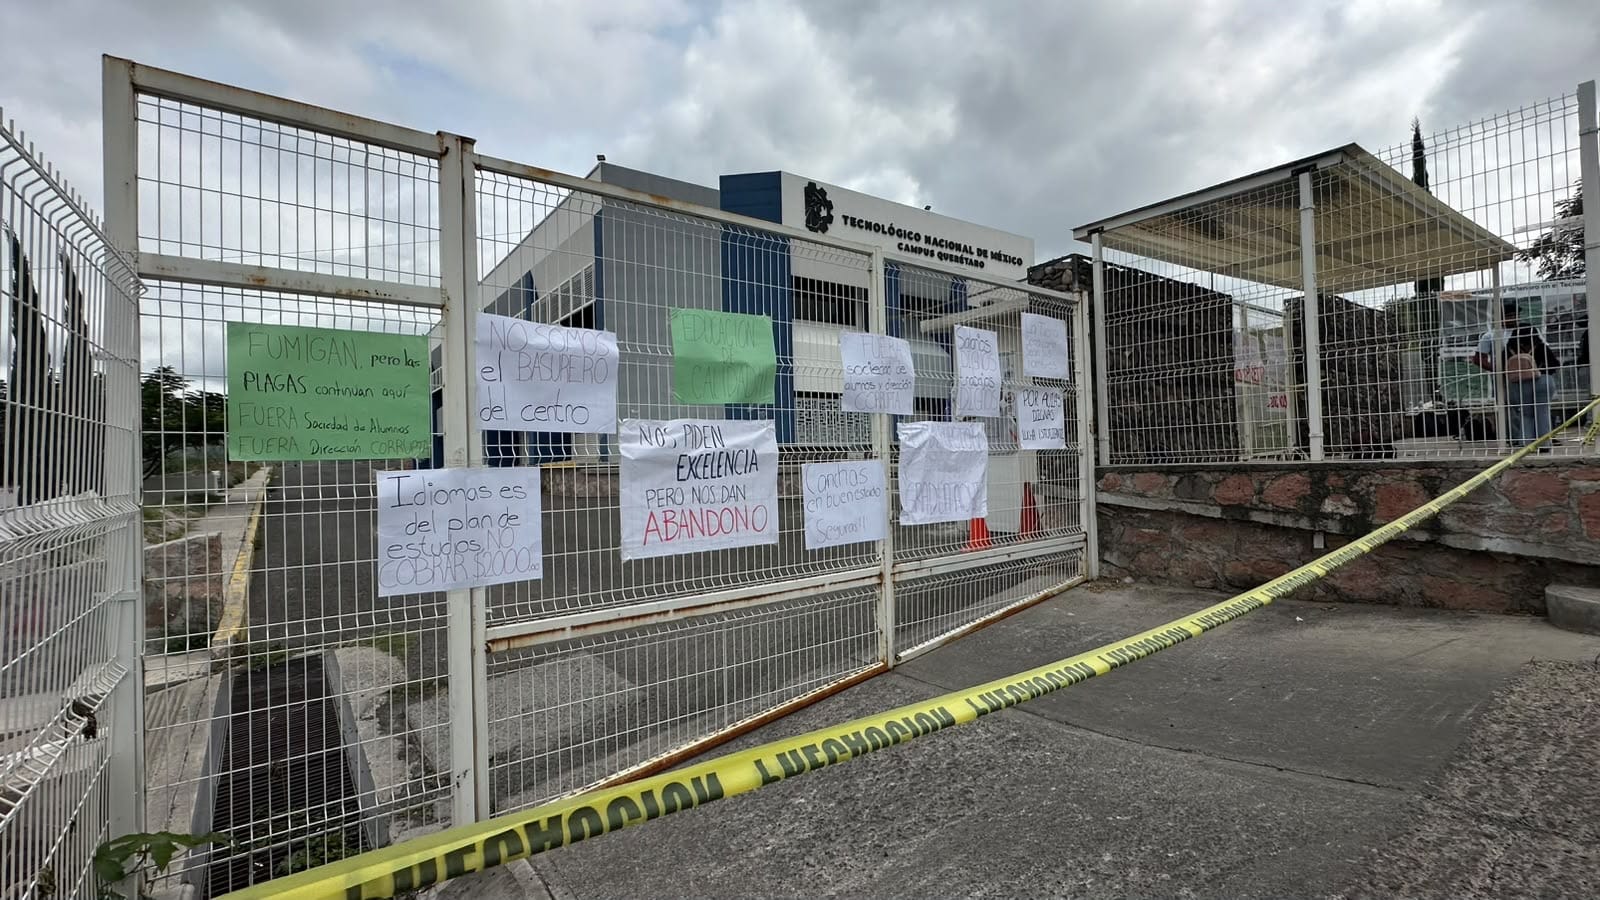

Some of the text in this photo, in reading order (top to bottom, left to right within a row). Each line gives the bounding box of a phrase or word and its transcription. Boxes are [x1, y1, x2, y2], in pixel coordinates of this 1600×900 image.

[842, 214, 1023, 266] TECNOLÓGICO NACIONAL DE MÉXICO
[897, 242, 985, 268] CAMPUS QUERÉTARO
[489, 320, 609, 356] NO SOMOS
[371, 353, 401, 368] pero
[404, 349, 421, 367] las
[480, 351, 502, 382] el
[243, 371, 307, 394] PLAGAS
[382, 384, 411, 400] aquí
[1022, 389, 1038, 407] POR
[238, 402, 410, 434] FUERA Sociedad de Alumnos
[480, 385, 590, 425] del centro
[238, 435, 298, 456] FUERA
[310, 439, 362, 455] Dirección
[639, 424, 725, 449] NOS PIDEN
[676, 449, 759, 482] EXCELENCIA
[806, 463, 868, 494] Canchas
[387, 475, 527, 508] Idiomas es
[646, 484, 746, 509] PERO NOS DAN
[806, 496, 823, 513] en
[826, 491, 853, 508] buen
[405, 504, 521, 541] del plan de
[488, 526, 515, 549] NO
[643, 504, 768, 546] ABANDONO
[379, 551, 468, 588] COBRAR
